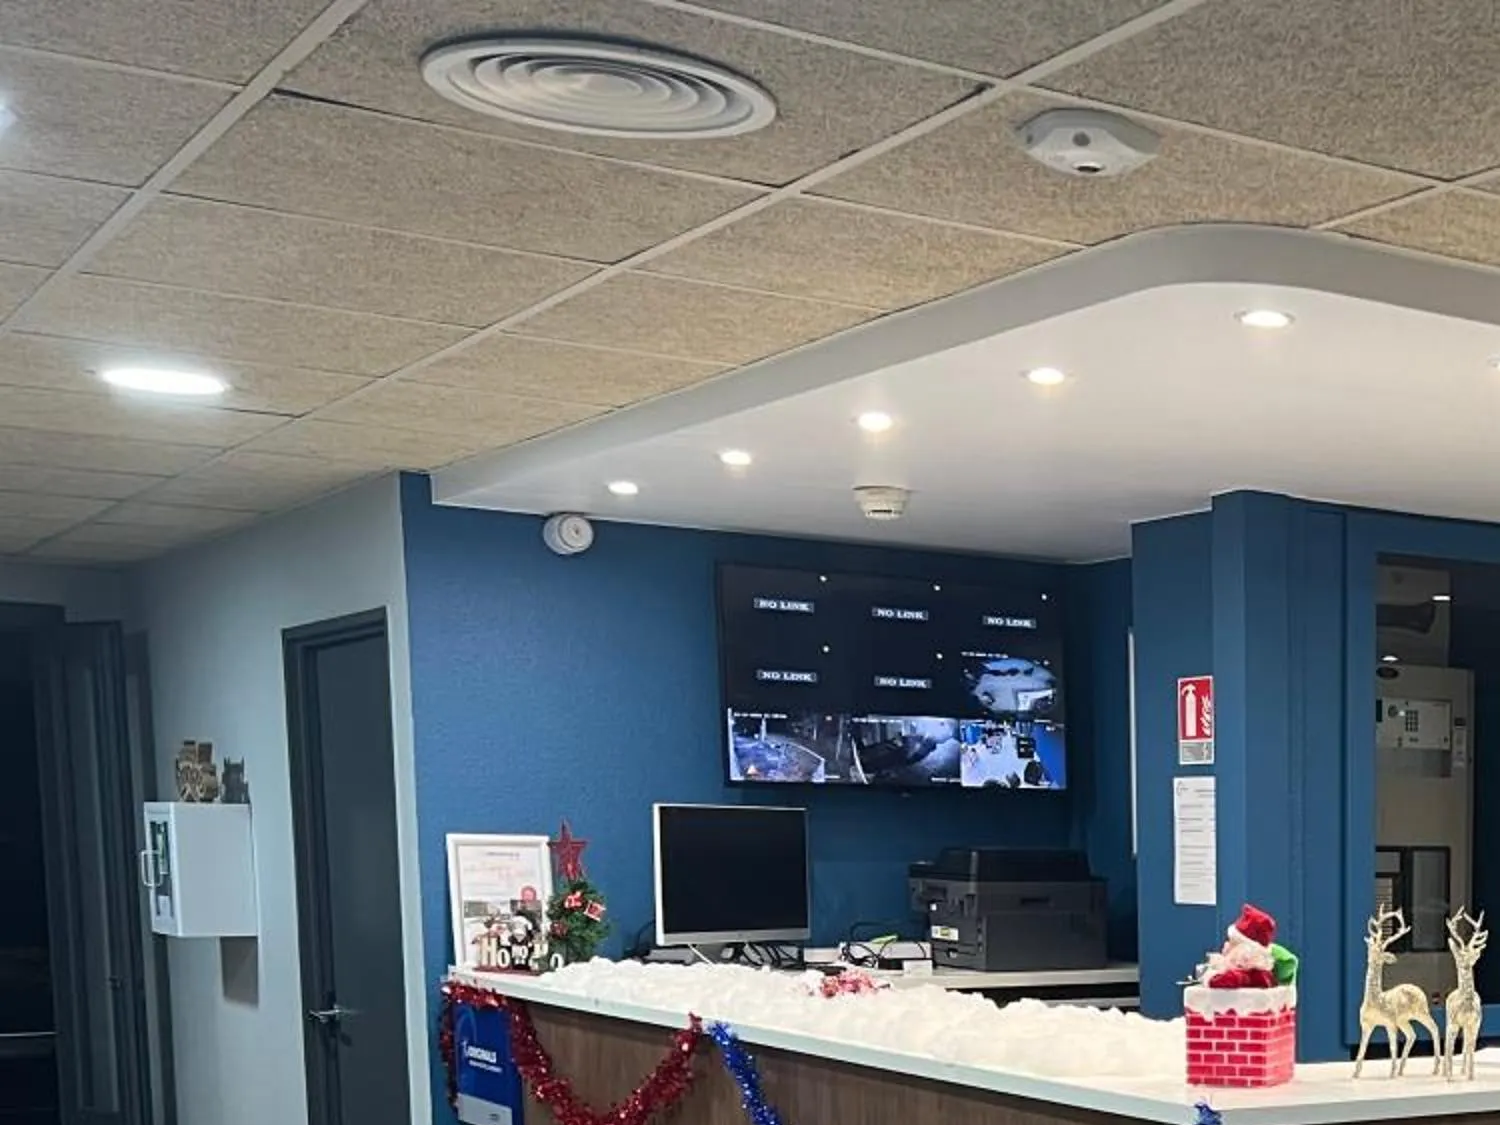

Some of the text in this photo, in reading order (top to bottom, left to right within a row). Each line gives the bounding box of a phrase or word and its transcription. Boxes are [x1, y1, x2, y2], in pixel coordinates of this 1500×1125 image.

[759, 599, 810, 611] NO LINK
[877, 608, 924, 620] NO LINK
[987, 616, 1032, 628] NO LINK
[761, 670, 812, 682] NO LINK
[879, 676, 928, 688] NO LINK
